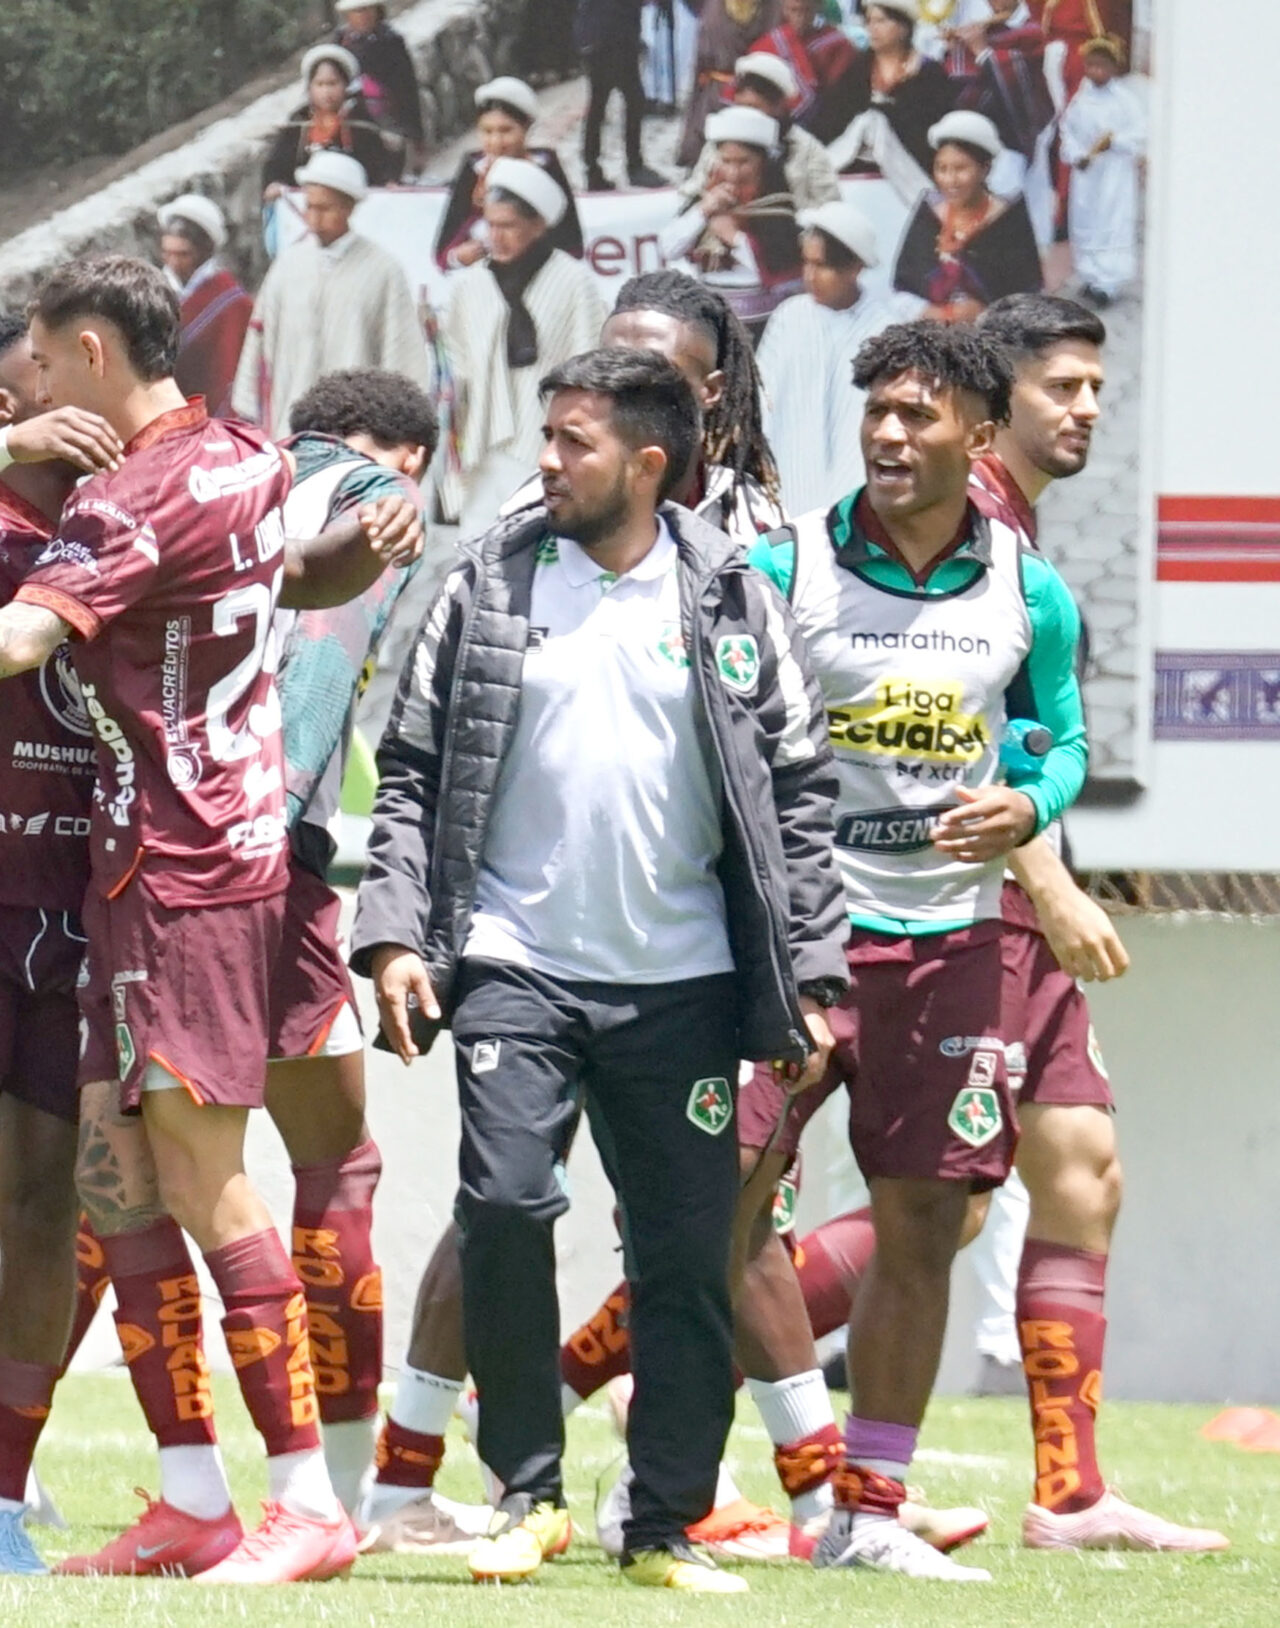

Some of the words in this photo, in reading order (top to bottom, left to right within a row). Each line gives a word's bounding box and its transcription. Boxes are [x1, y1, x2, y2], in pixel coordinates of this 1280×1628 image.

[851, 630, 991, 656] marathon
[886, 683, 954, 717] Liga
[1021, 1320, 1081, 1510] ROLAND
